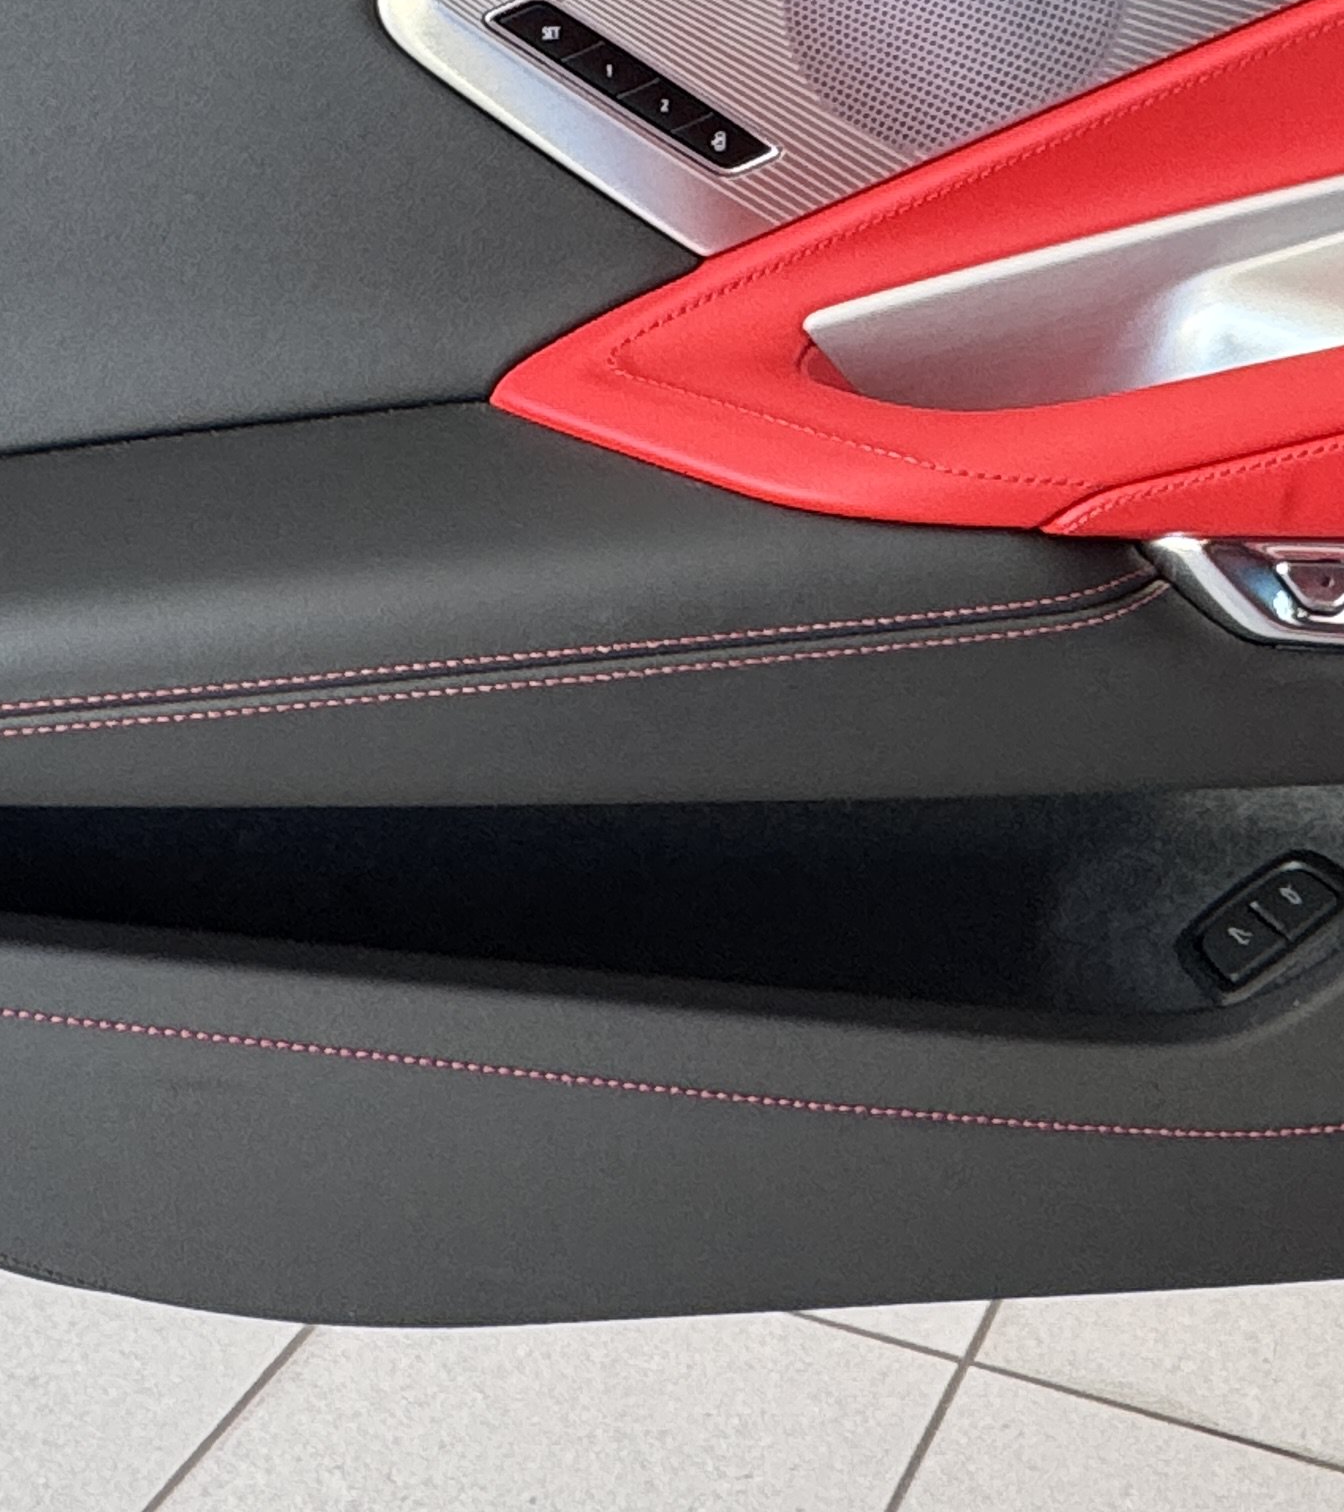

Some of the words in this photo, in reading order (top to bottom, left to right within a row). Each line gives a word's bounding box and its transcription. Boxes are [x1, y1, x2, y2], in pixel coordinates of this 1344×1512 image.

[542, 26, 561, 40] SET
[607, 64, 613, 78] 1
[660, 99, 670, 113] 2
